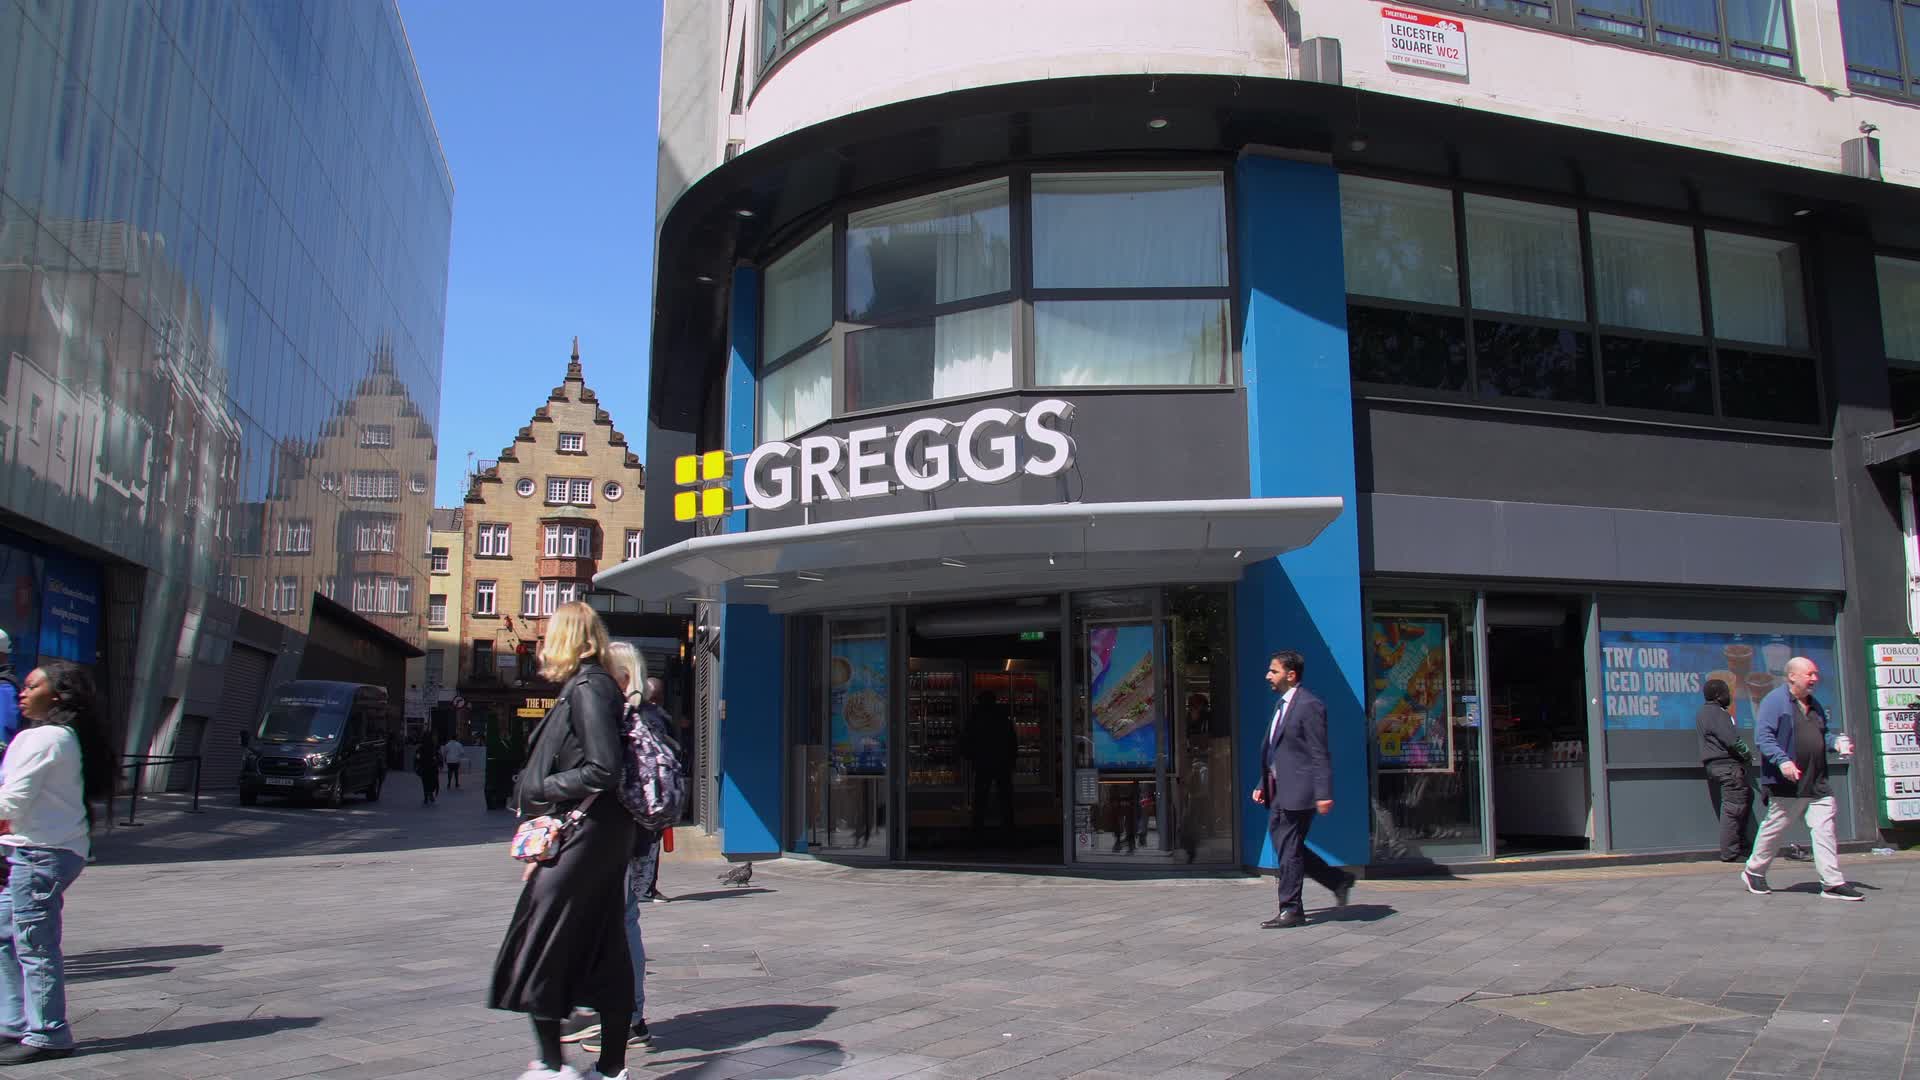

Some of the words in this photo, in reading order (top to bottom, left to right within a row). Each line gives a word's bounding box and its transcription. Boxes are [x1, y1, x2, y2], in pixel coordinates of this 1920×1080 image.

[1391, 23, 1444, 44] LEICESTER
[1392, 37, 1433, 55] SQUARE
[1436, 45, 1459, 60] WC2
[743, 399, 1076, 511] GREGGS
[1603, 647, 1633, 669] TRY
[1638, 647, 1669, 669] OUR
[1881, 646, 1918, 656] TOBACCO
[1605, 671, 1640, 692] ICED
[1645, 671, 1701, 693] DRINKS
[1888, 668, 1918, 685] JUUL
[526, 698, 539, 708] THE
[1606, 695, 1660, 716] RANGE
